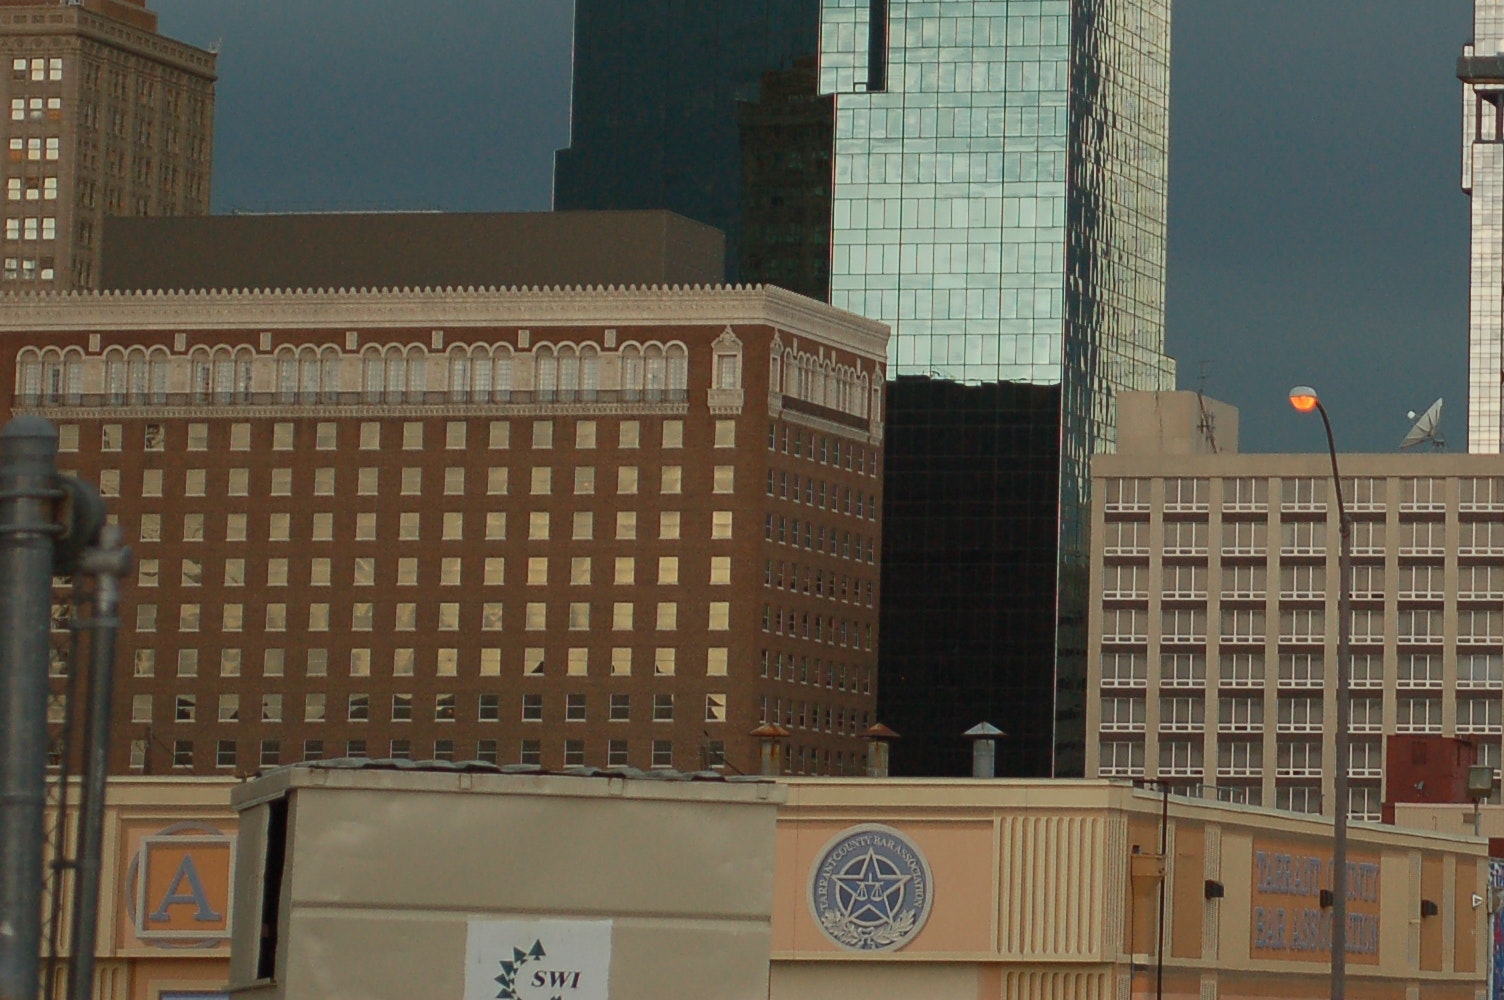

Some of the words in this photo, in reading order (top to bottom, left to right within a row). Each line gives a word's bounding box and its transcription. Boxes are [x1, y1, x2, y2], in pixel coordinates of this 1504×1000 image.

[818, 857, 837, 911] TARRANT
[833, 836, 872, 861] COUNTY
[873, 835, 895, 849] BAR
[894, 844, 925, 908] ASSOCIATION
[1326, 857, 1380, 901] CNTY
[1254, 906, 1287, 950] BAR
[1289, 907, 1380, 954] ASSOCTION
[531, 969, 582, 989] SWI
